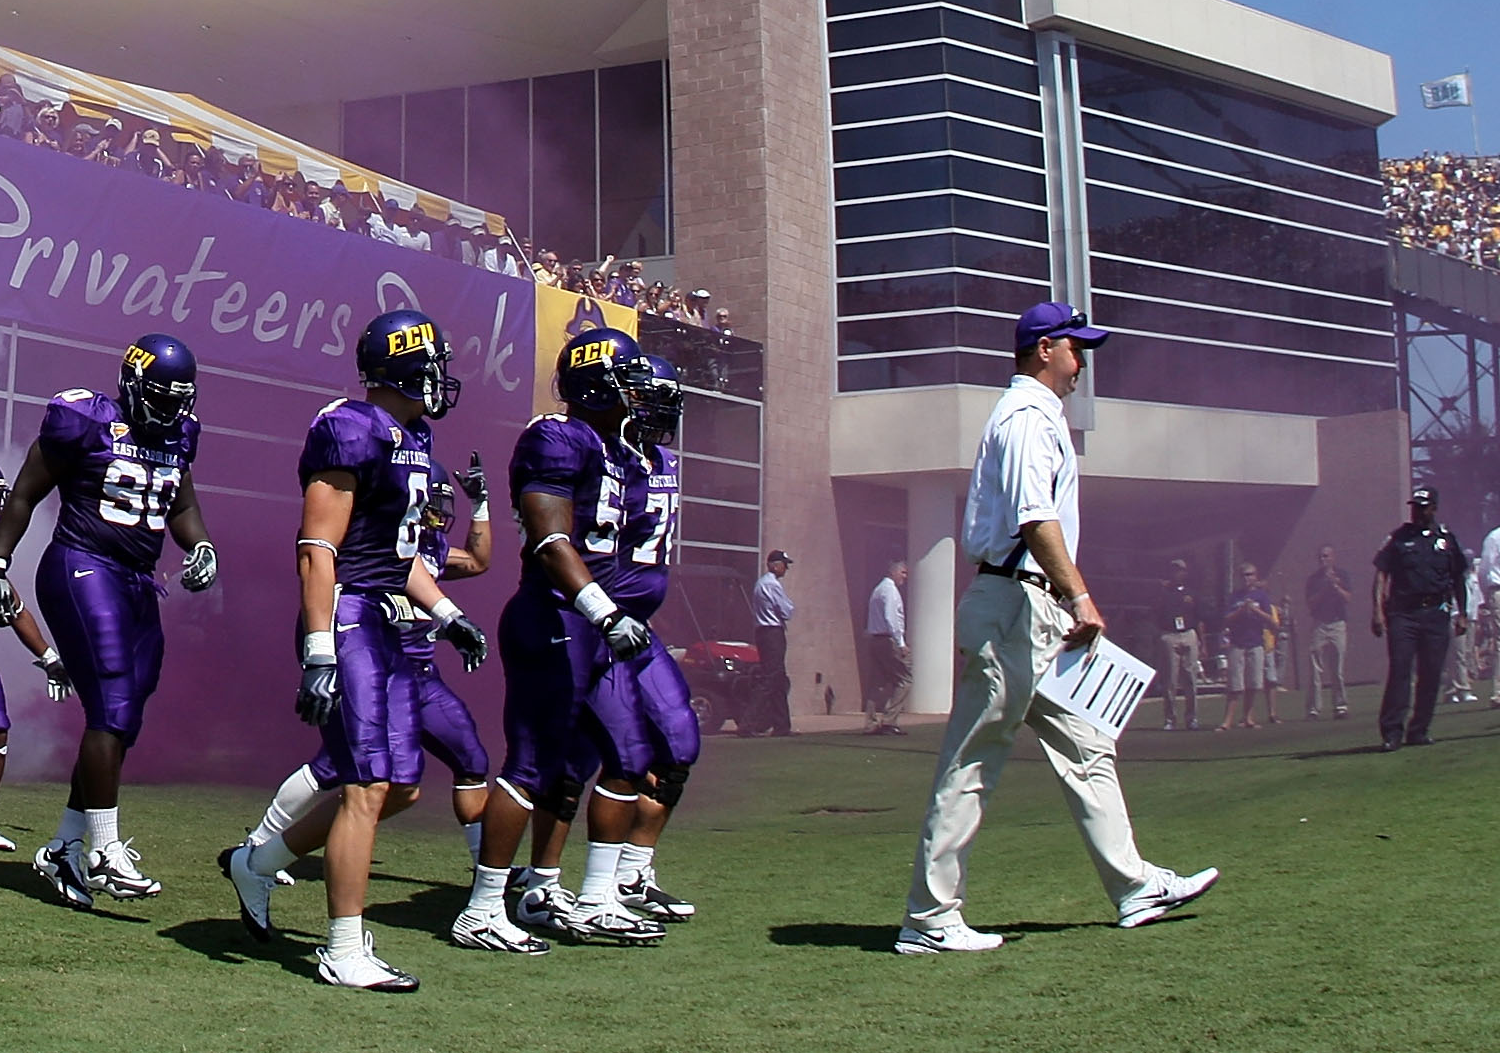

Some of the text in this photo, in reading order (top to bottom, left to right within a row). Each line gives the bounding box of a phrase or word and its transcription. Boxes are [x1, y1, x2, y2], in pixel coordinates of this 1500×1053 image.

[387, 323, 435, 356] ECU
[123, 345, 156, 370] ECU
[569, 340, 616, 368] ECU
[112, 441, 138, 458] EAST
